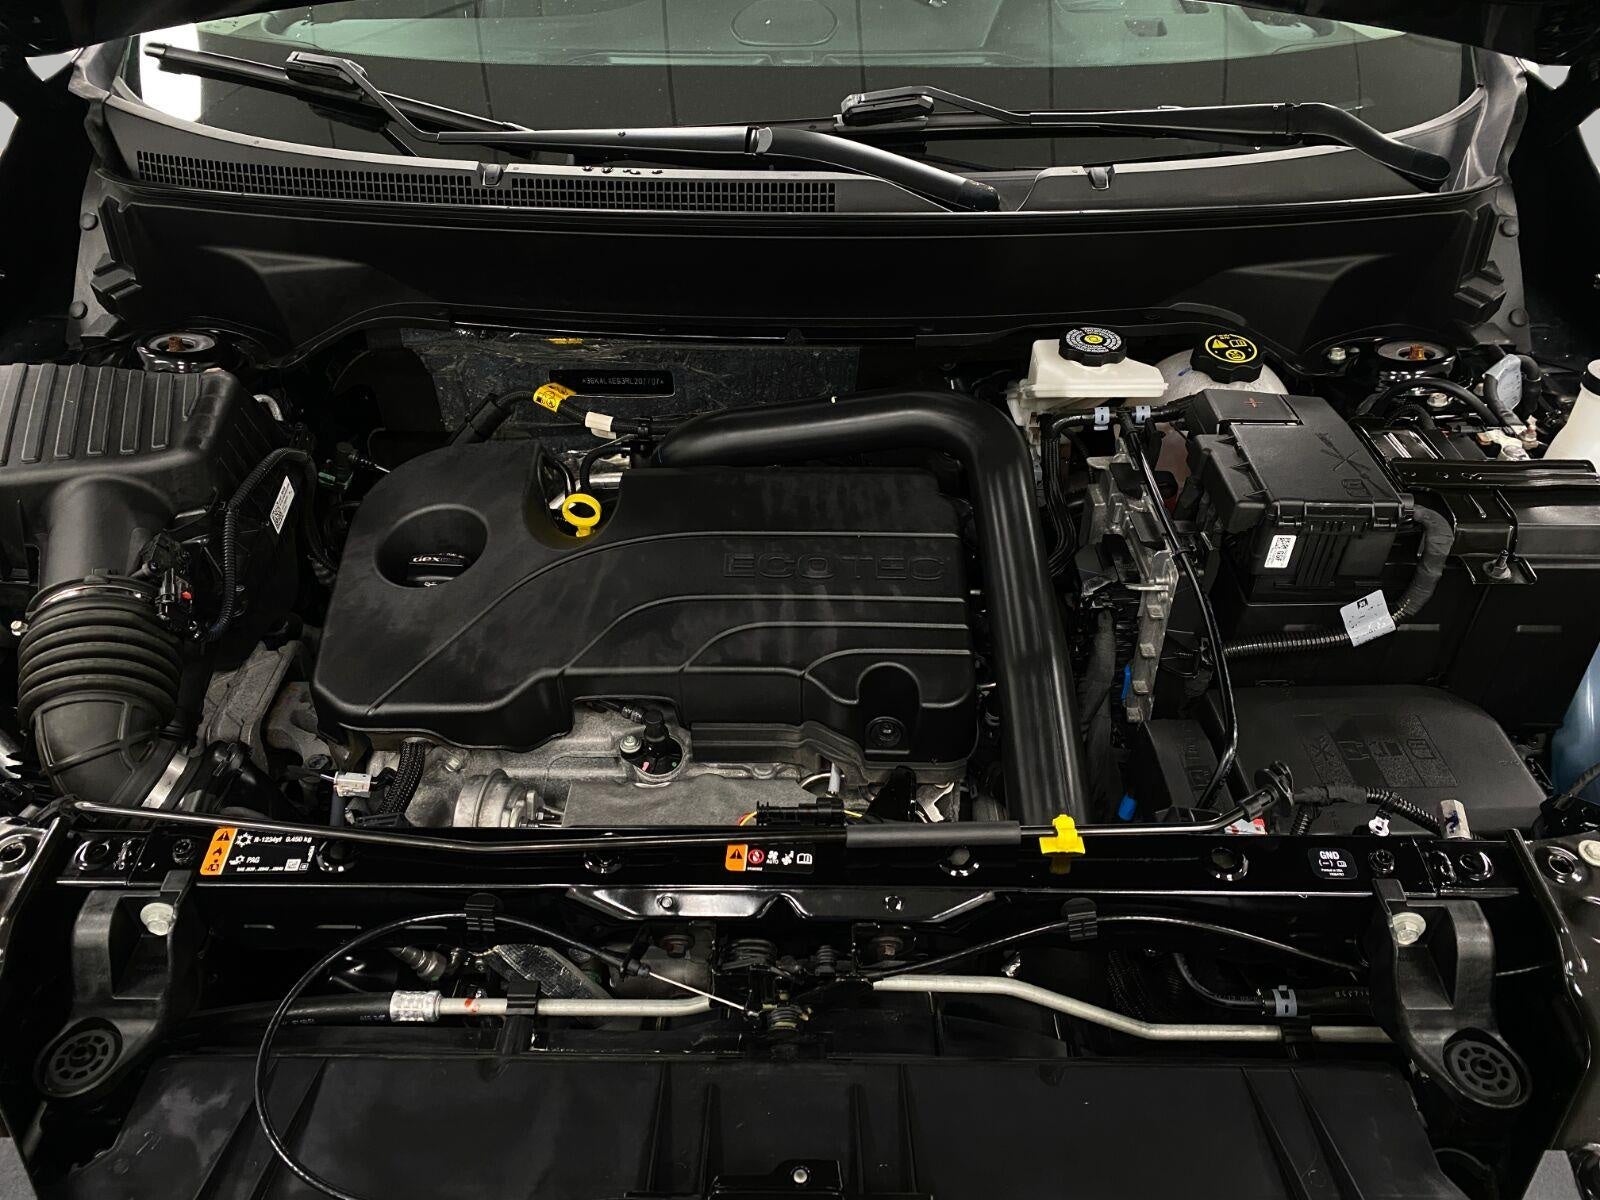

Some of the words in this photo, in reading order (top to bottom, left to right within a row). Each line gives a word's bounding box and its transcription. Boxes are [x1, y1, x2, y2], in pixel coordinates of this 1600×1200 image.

[724, 552, 945, 580] ECOTEC
[246, 856, 260, 864] PAG
[1319, 850, 1340, 860] GND
